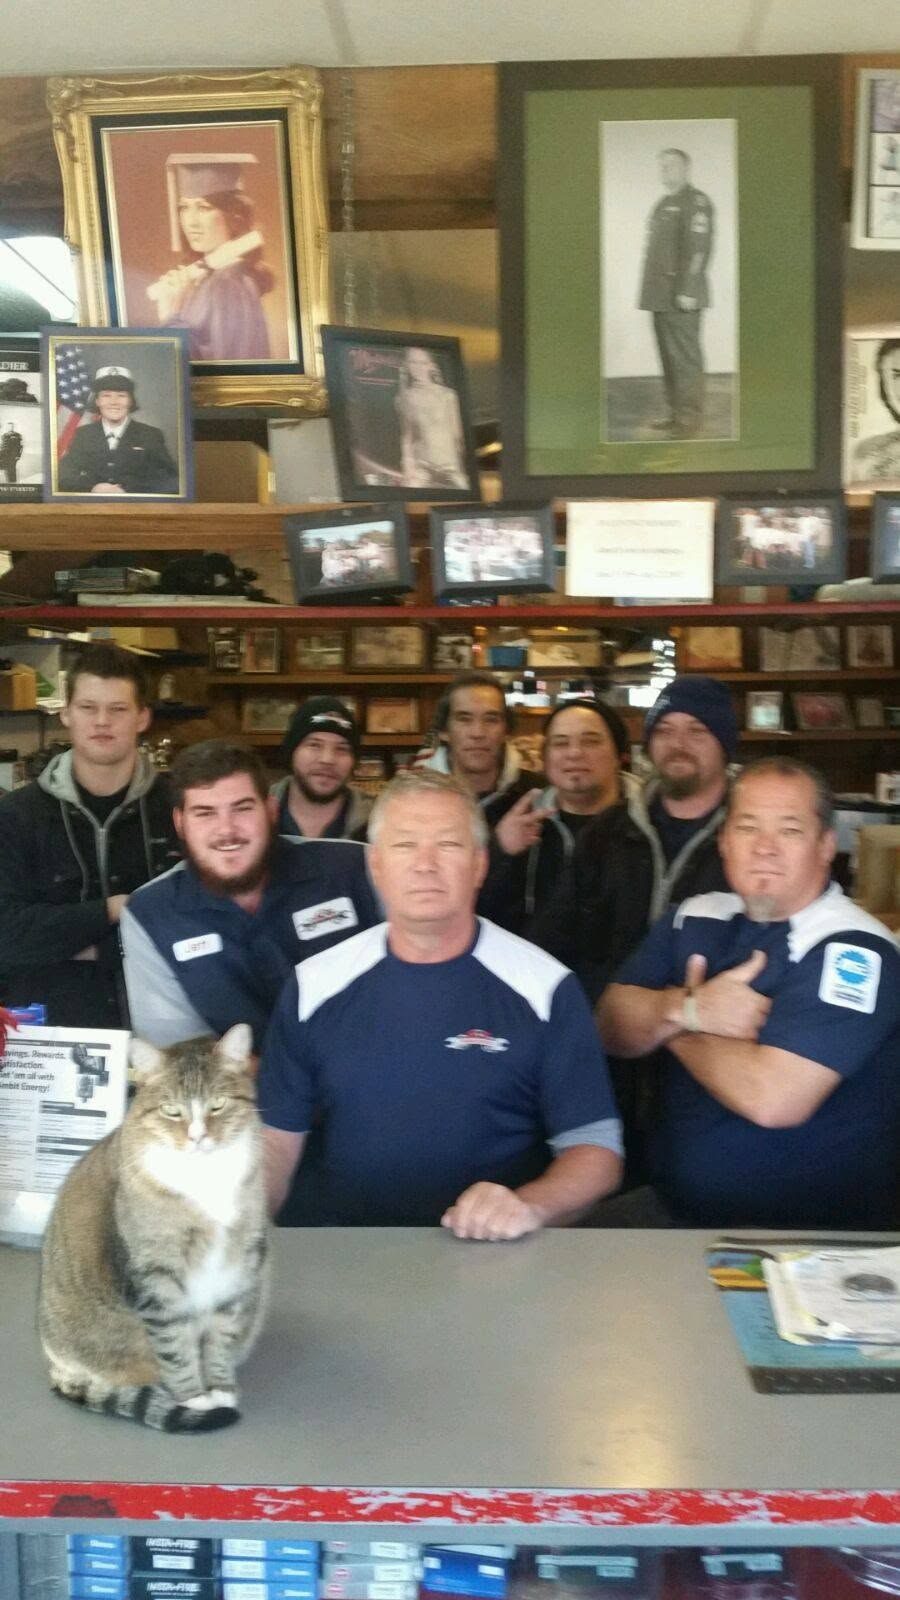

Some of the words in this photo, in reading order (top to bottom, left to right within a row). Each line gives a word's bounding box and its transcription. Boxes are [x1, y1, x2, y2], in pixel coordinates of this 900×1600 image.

[0, 361, 29, 371] DIER
[4, 1049, 30, 1059] avings.
[37, 1072, 55, 1081] with
